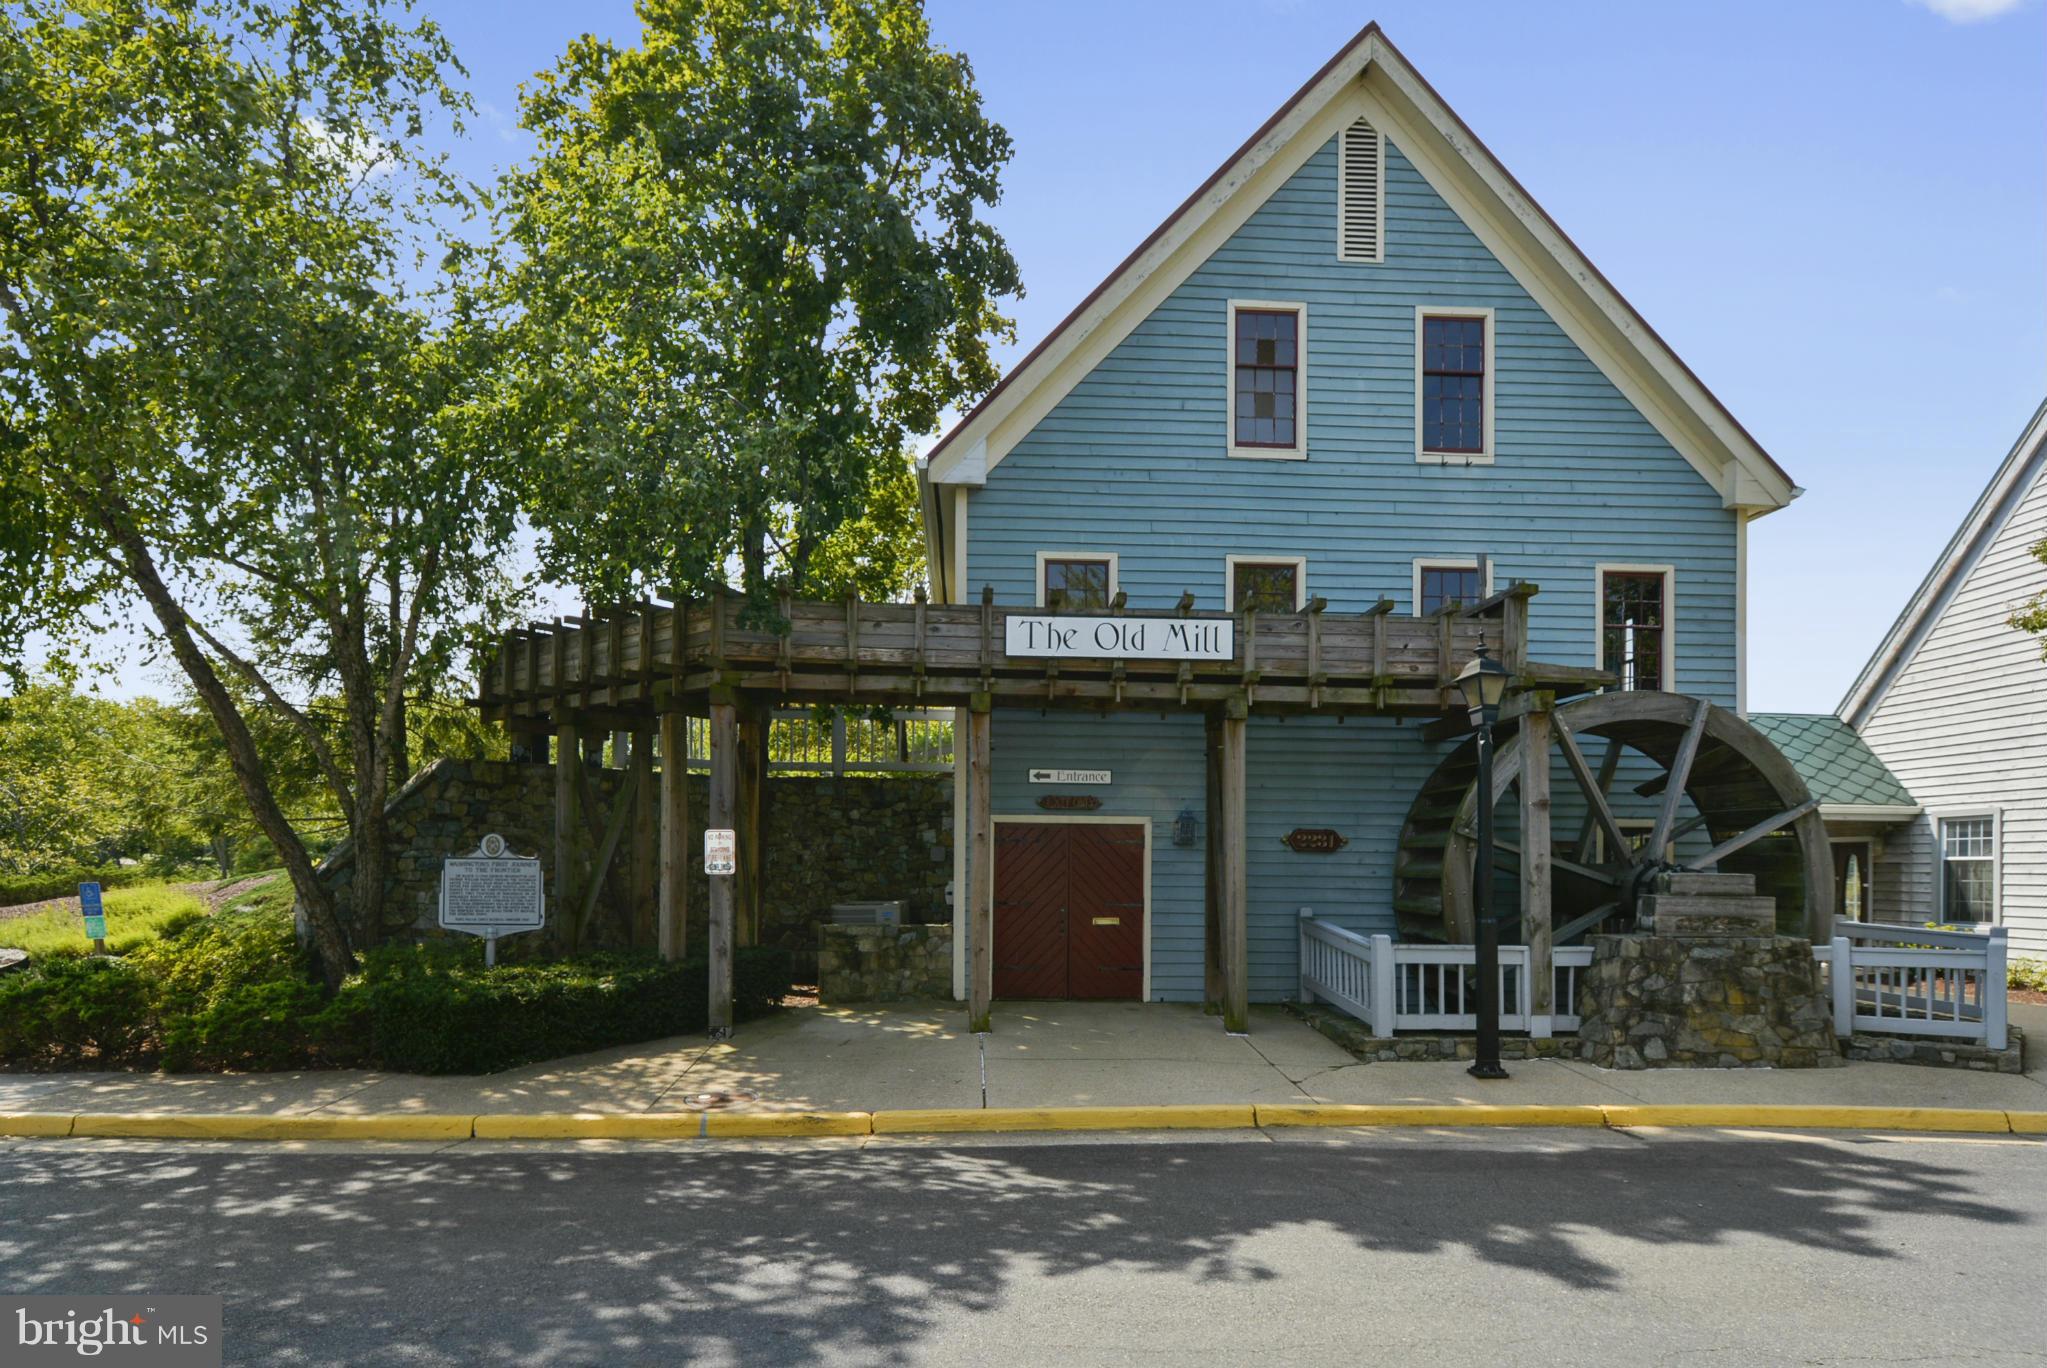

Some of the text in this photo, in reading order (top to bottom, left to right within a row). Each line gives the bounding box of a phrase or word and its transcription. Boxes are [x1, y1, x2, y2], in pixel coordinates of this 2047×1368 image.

[1018, 620, 1221, 653] The Old Mill
[1057, 771, 1107, 782] Entrance
